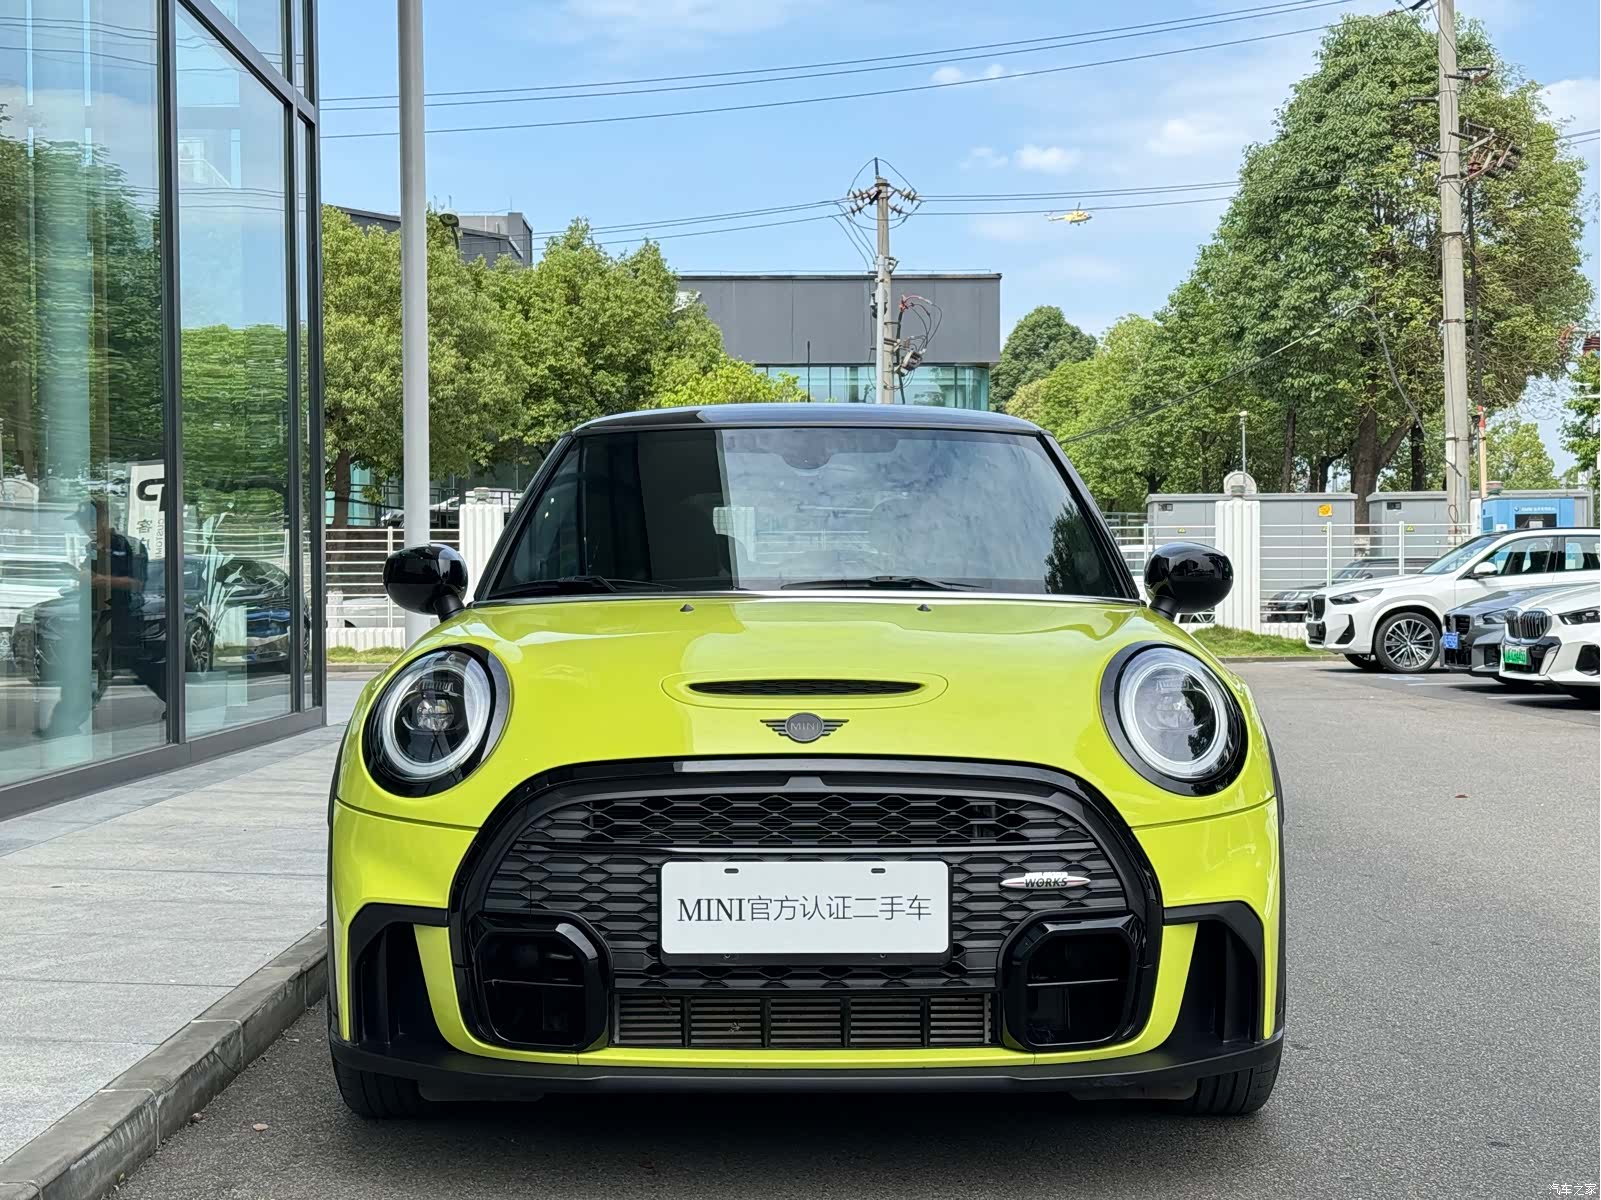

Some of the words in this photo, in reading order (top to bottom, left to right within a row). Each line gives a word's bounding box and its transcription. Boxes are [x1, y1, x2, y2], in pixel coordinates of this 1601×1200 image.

[1025, 877, 1067, 888] WORKS
[677, 895, 932, 921] MINI官方认证二手车
